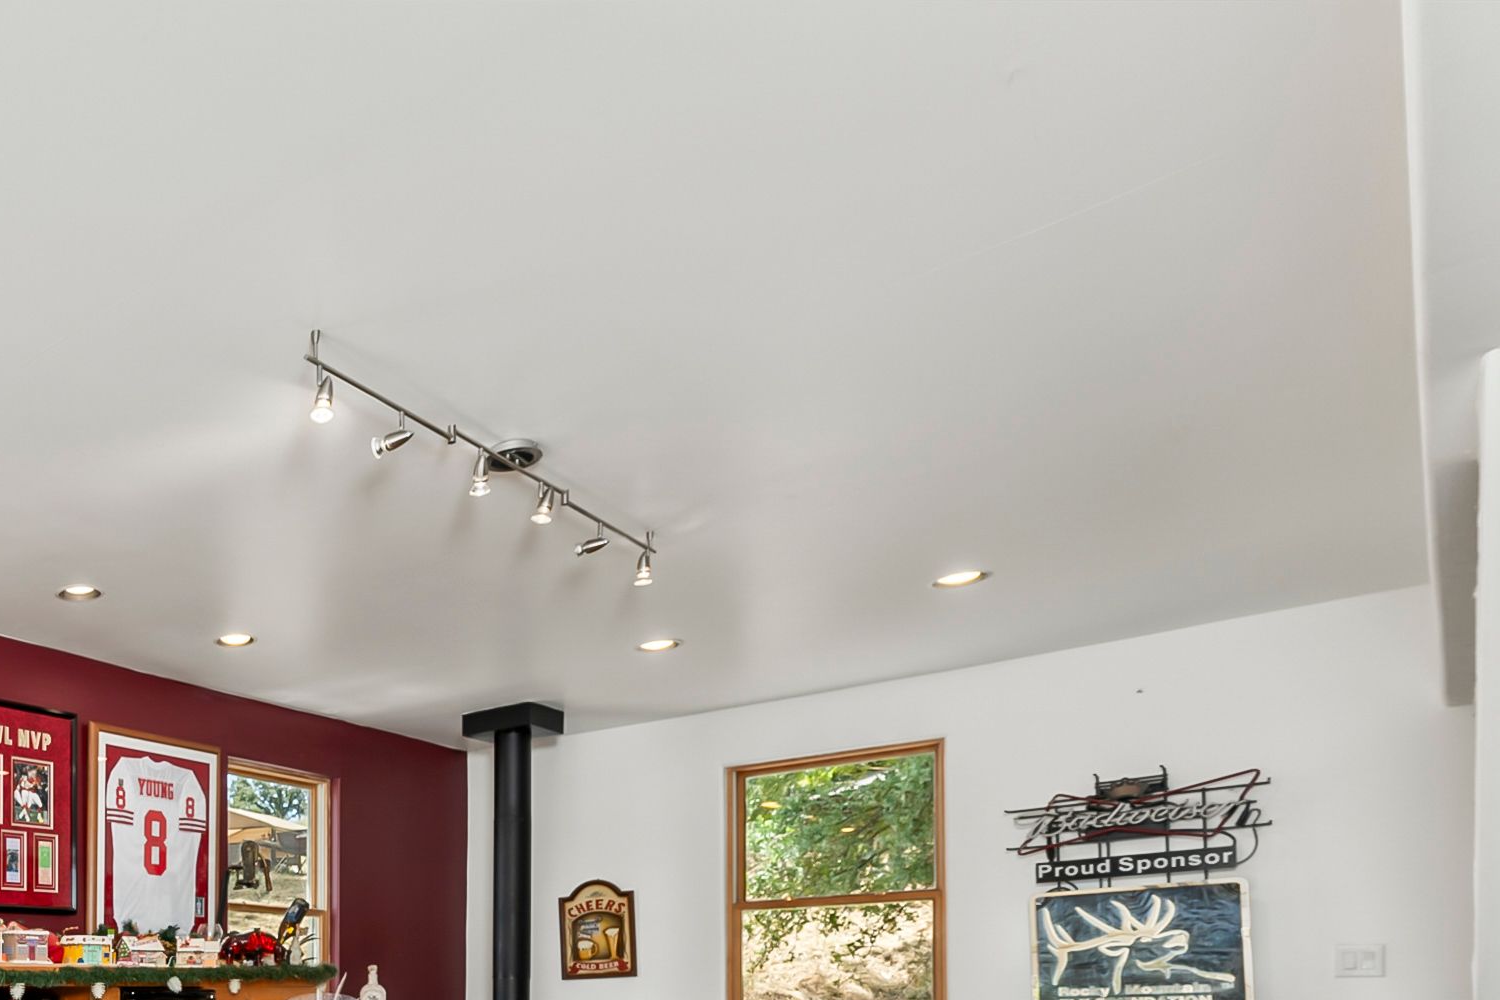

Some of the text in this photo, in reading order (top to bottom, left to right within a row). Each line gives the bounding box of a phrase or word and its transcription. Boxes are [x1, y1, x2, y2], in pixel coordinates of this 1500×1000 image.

[17, 728, 52, 752] MVP
[116, 786, 126, 809] 8
[137, 778, 174, 801] YOUNG
[185, 797, 195, 818] 8
[143, 809, 167, 876] 8
[1037, 850, 1233, 879] Proud Sponsor
[567, 898, 626, 918] CHEERS
[1057, 985, 1110, 998] Rocky
[1124, 982, 1212, 995] Mountain
